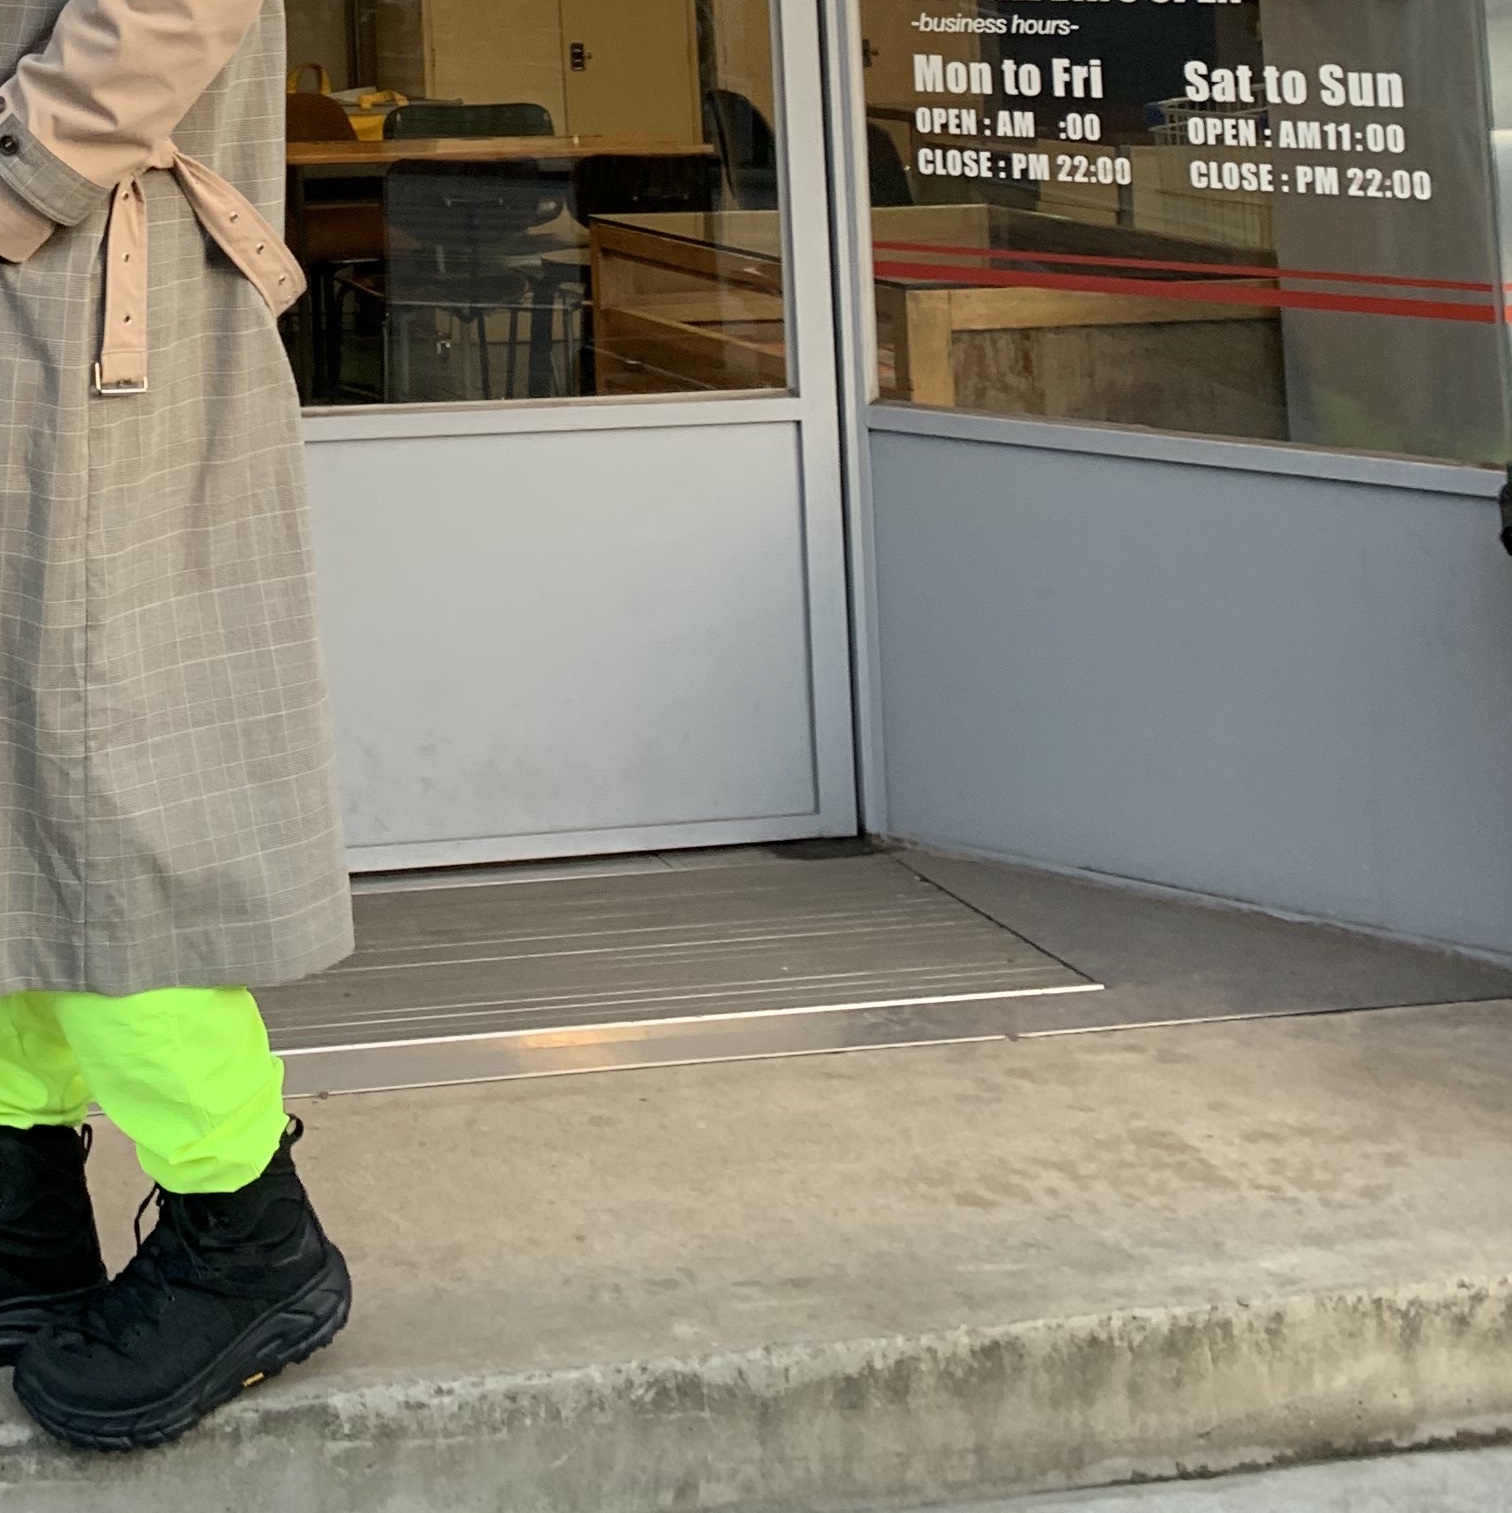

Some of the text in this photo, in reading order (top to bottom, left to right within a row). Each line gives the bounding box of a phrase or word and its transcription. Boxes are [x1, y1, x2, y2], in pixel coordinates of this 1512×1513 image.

[913, 54, 1104, 99] Mon to Fri
[1183, 60, 1405, 108] Sat to Sun
[915, 107, 978, 136] OPEN
[996, 110, 1036, 138] AM
[1187, 117, 1257, 147] OPEN
[917, 148, 992, 178] CLOSE
[1011, 153, 1050, 181] PM
[1056, 154, 1132, 186] 22:00
[1190, 160, 1275, 192] CLOSE
[1295, 165, 1340, 196] PM
[1346, 168, 1433, 201] 22:00
